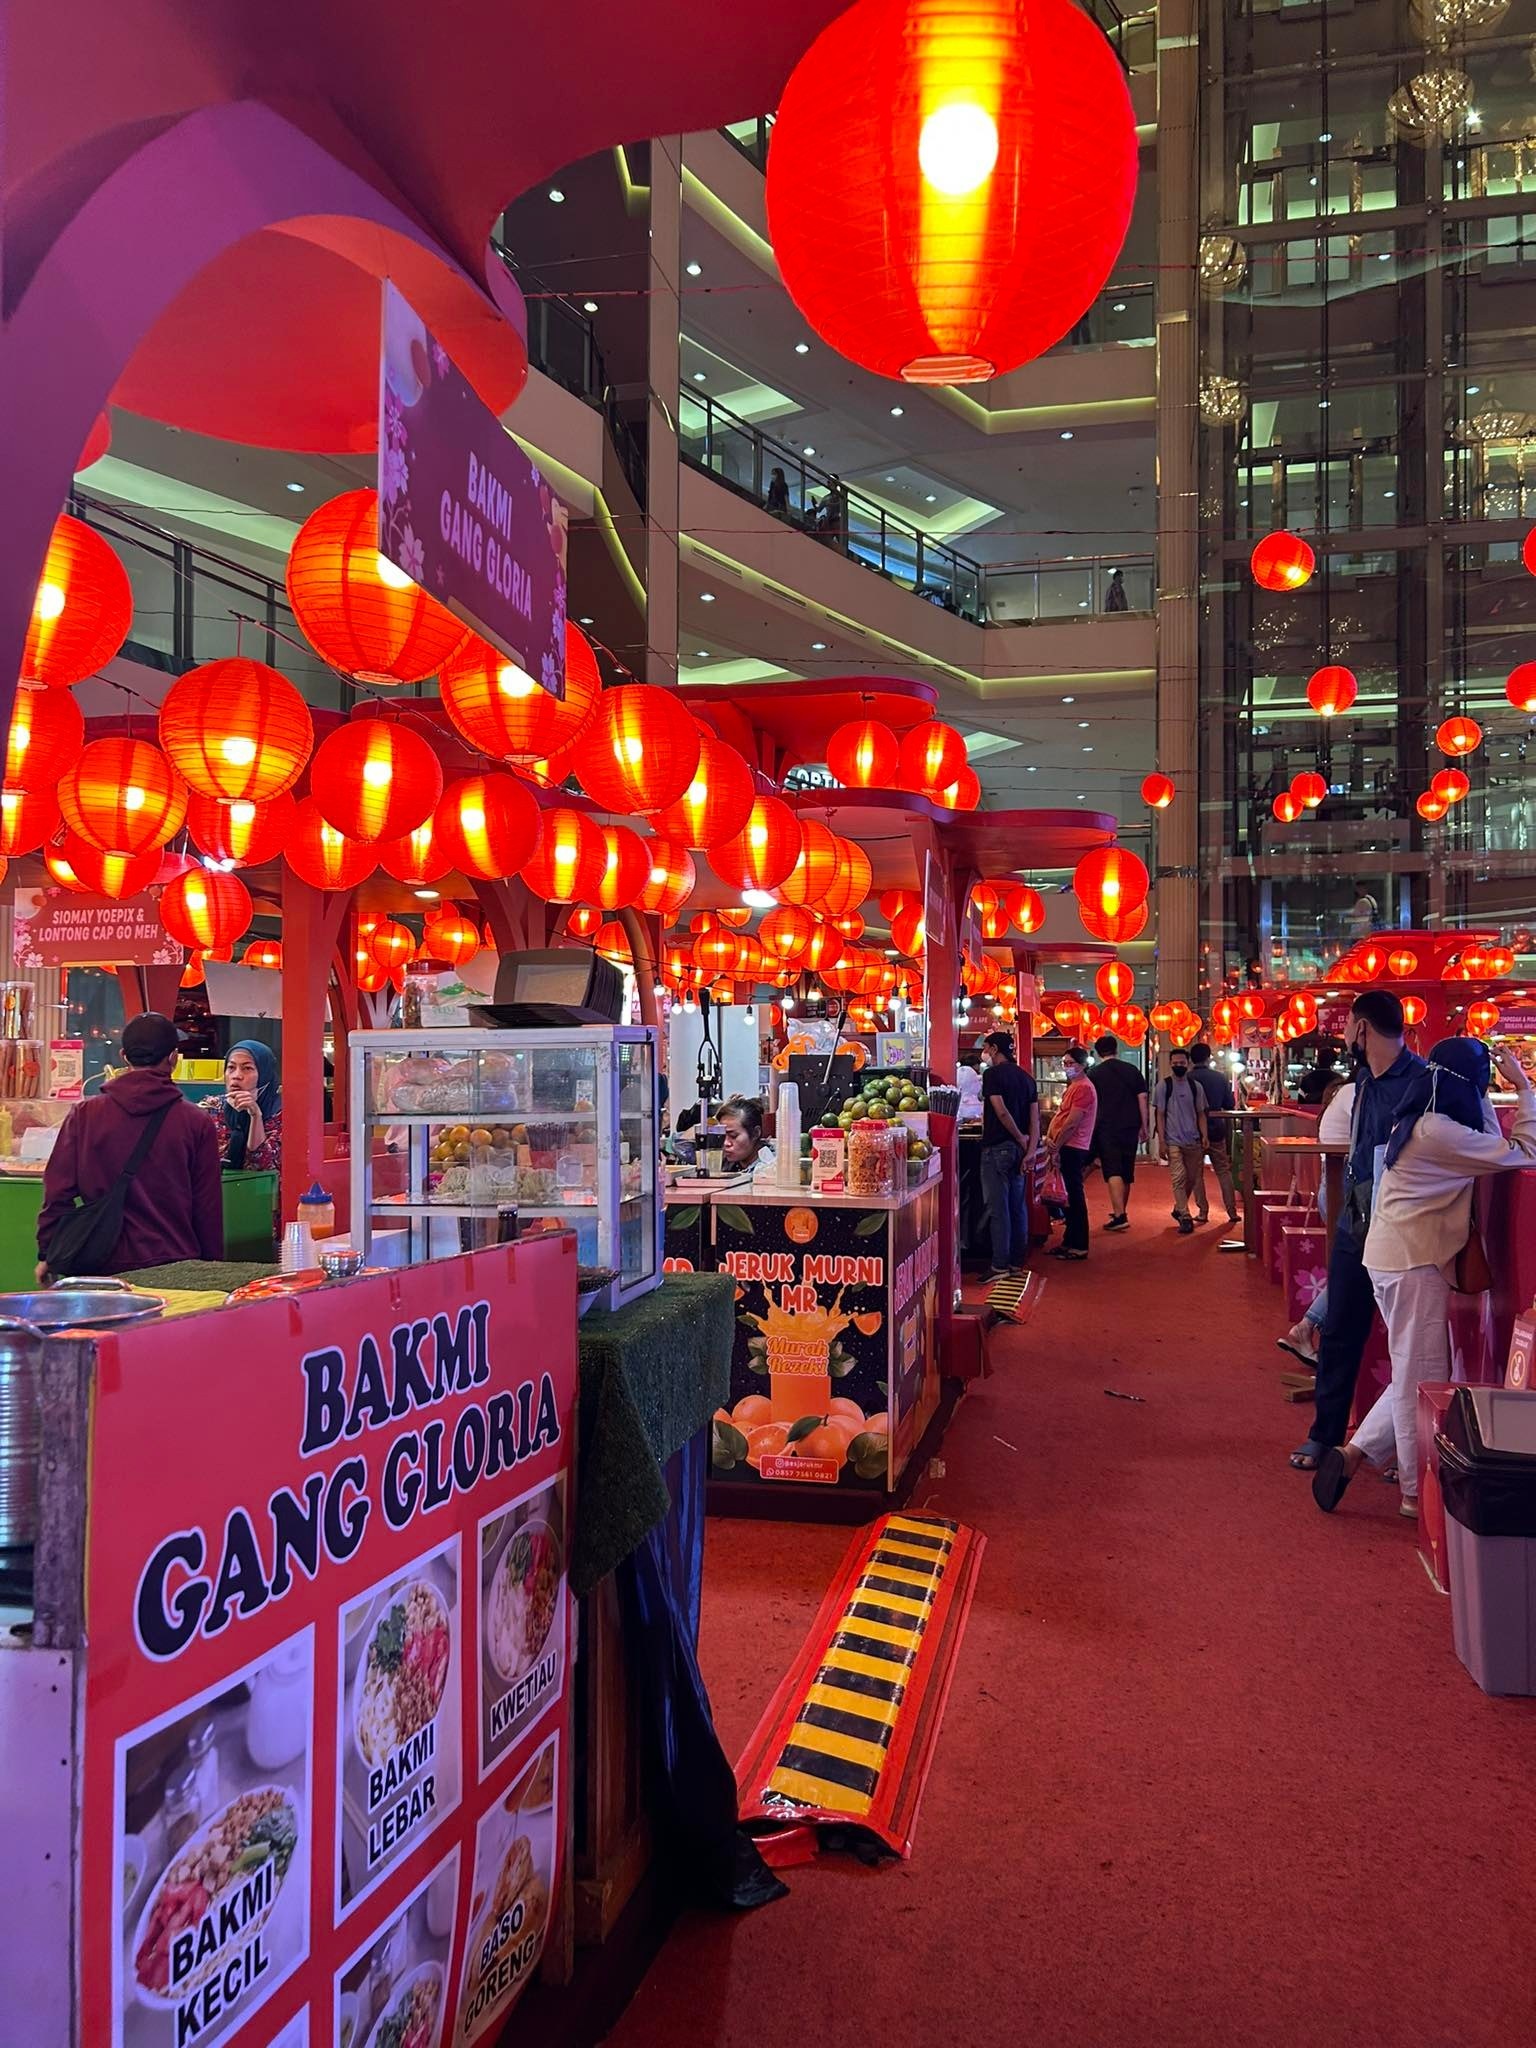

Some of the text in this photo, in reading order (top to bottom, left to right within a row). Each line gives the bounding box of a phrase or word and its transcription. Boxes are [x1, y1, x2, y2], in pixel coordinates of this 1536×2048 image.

[468, 451, 513, 541] BAKMI
[440, 490, 533, 621] GANG GLORIA
[38, 923, 158, 942] LONTONG CAP GO MEH
[52, 907, 145, 925] SIOMAY YOEPIX &
[718, 1251, 797, 1283] JERUK
[803, 1254, 883, 1286] MURNI
[780, 1284, 818, 1314] MR
[300, 1300, 491, 1457] BAKMI
[766, 1336, 830, 1377] Murah Rezeki
[133, 1374, 560, 1662] GANG GLORIA
[490, 1655, 558, 1736] KWETIAU
[368, 1720, 436, 1811] BAKMI
[368, 1775, 437, 1867] LEBAR
[170, 1860, 275, 1986] BAKMI
[480, 1901, 525, 1975] BASO
[176, 1934, 271, 2048] KECIL
[464, 1934, 535, 2034] GORENG
